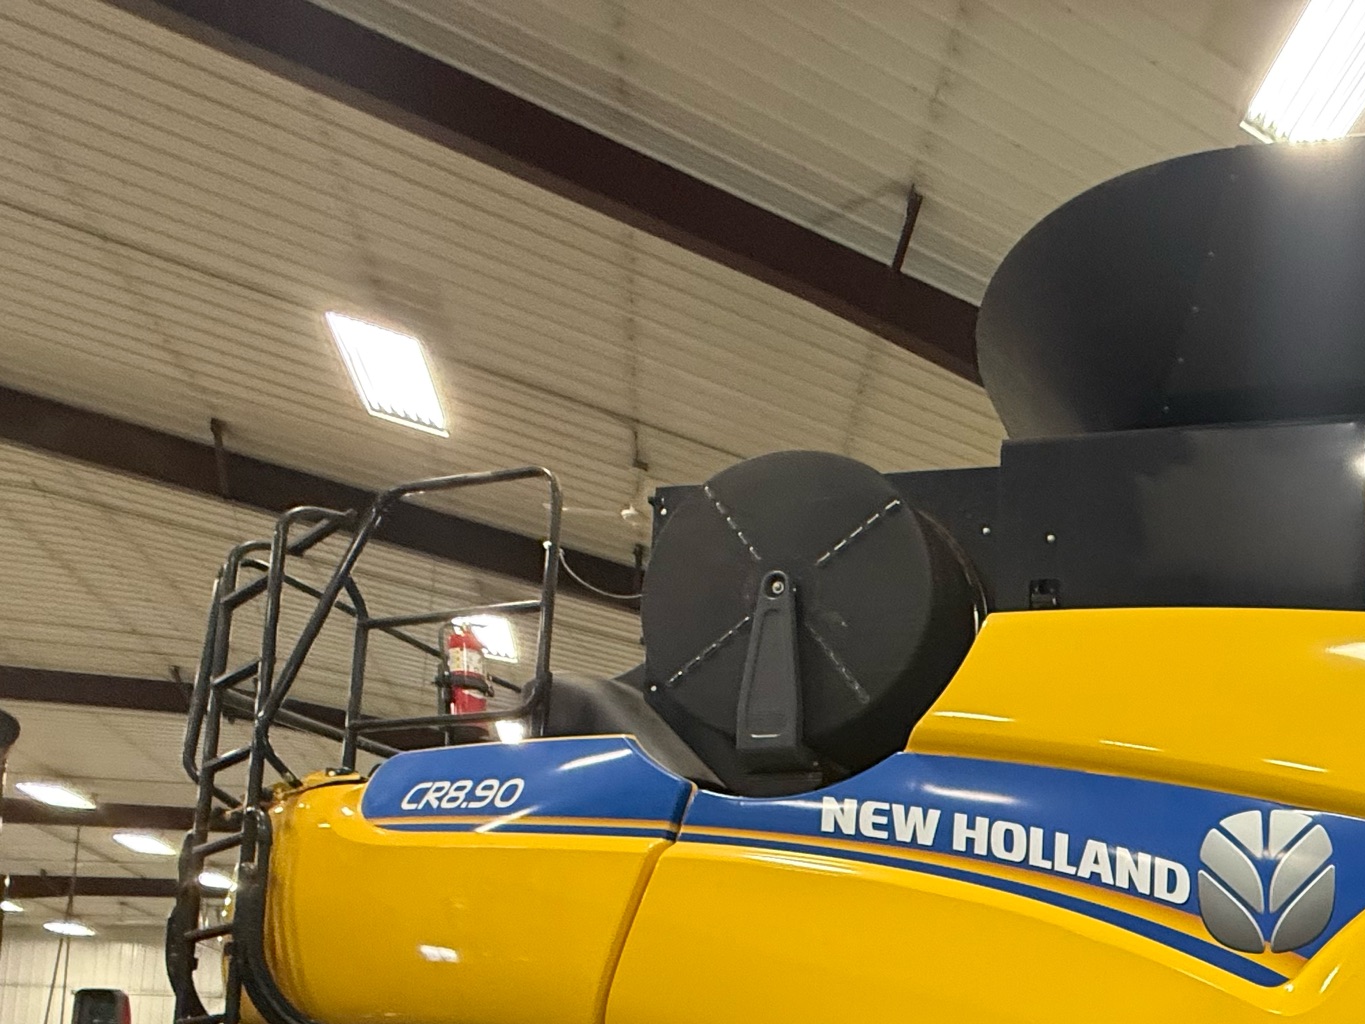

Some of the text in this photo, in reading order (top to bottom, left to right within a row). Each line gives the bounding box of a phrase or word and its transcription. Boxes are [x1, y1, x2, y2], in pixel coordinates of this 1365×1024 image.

[400, 777, 525, 811] CR8.90
[819, 796, 1192, 905] NEW HOLLAND
